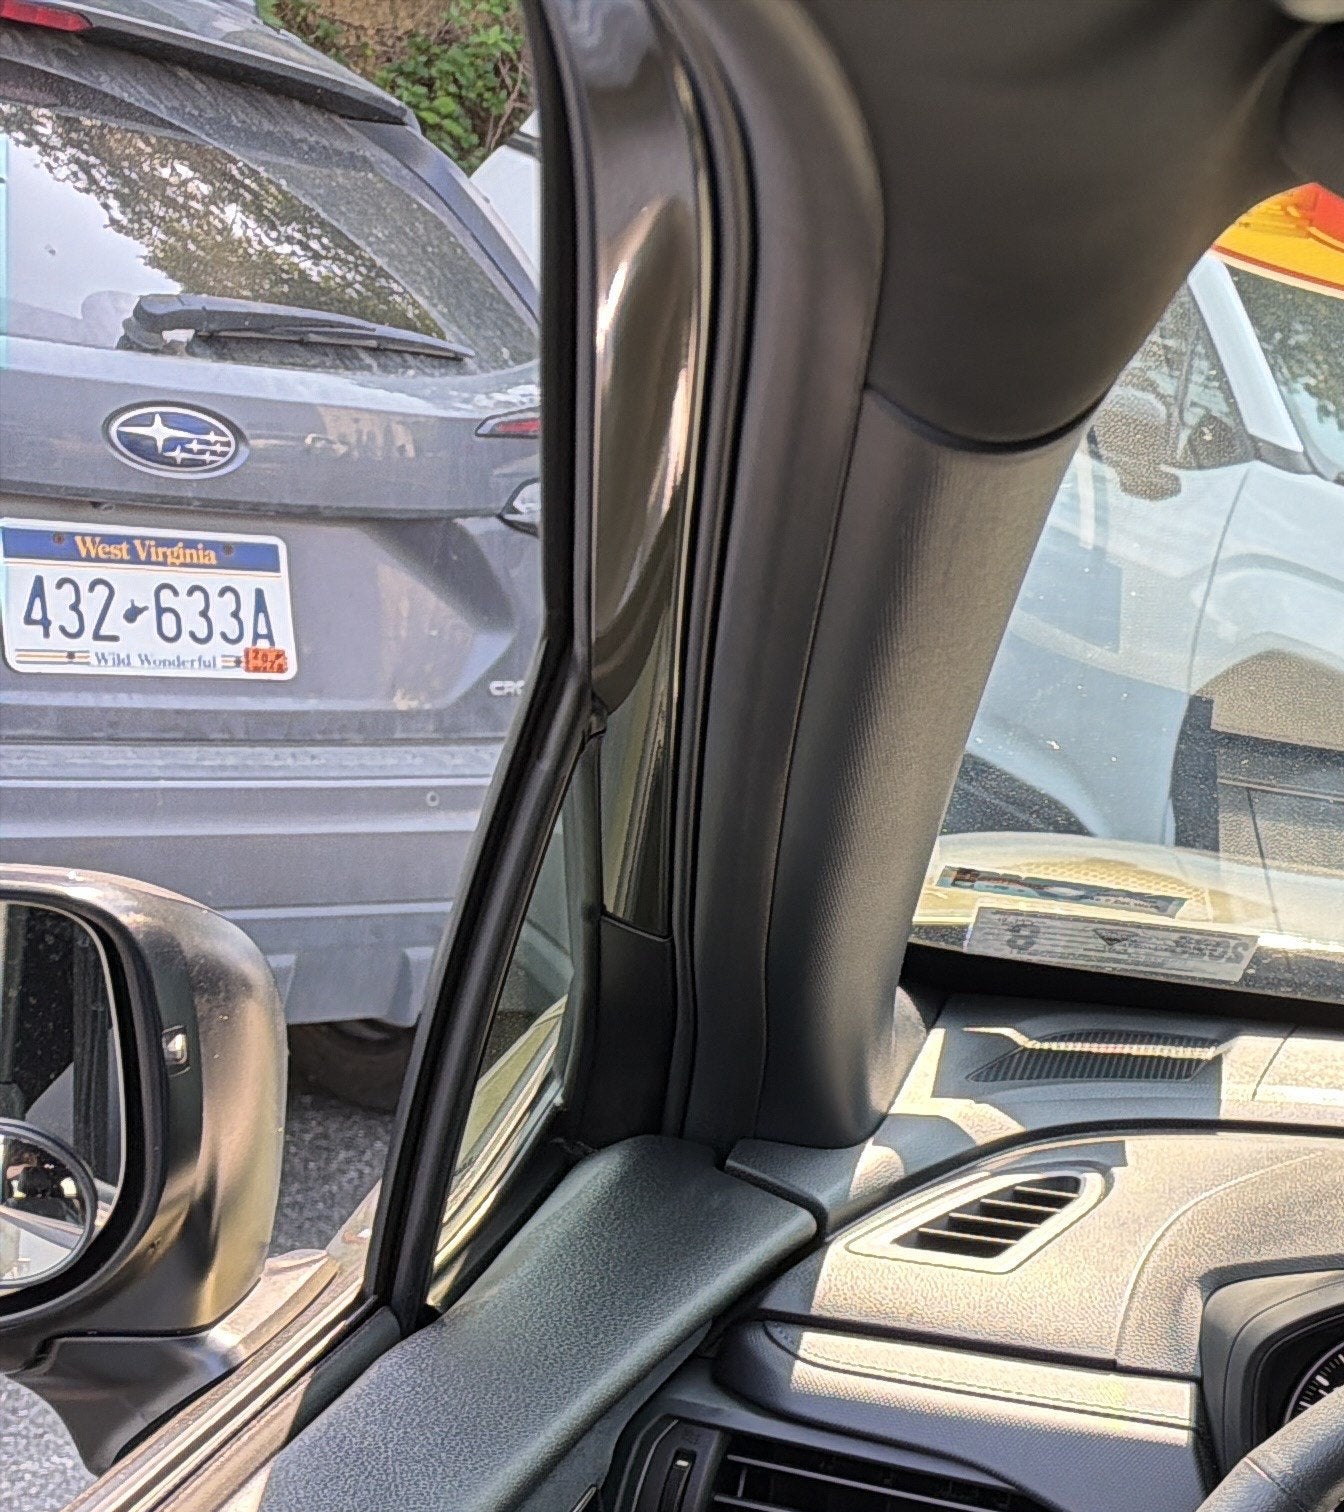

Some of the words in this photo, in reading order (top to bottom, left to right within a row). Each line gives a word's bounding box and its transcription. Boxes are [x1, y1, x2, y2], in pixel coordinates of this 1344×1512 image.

[74, 536, 130, 560] West
[134, 540, 217, 566] Virginia
[24, 575, 120, 642] 432
[154, 583, 275, 646] 633A
[95, 652, 131, 667] Wild
[138, 653, 217, 669] Wonderful
